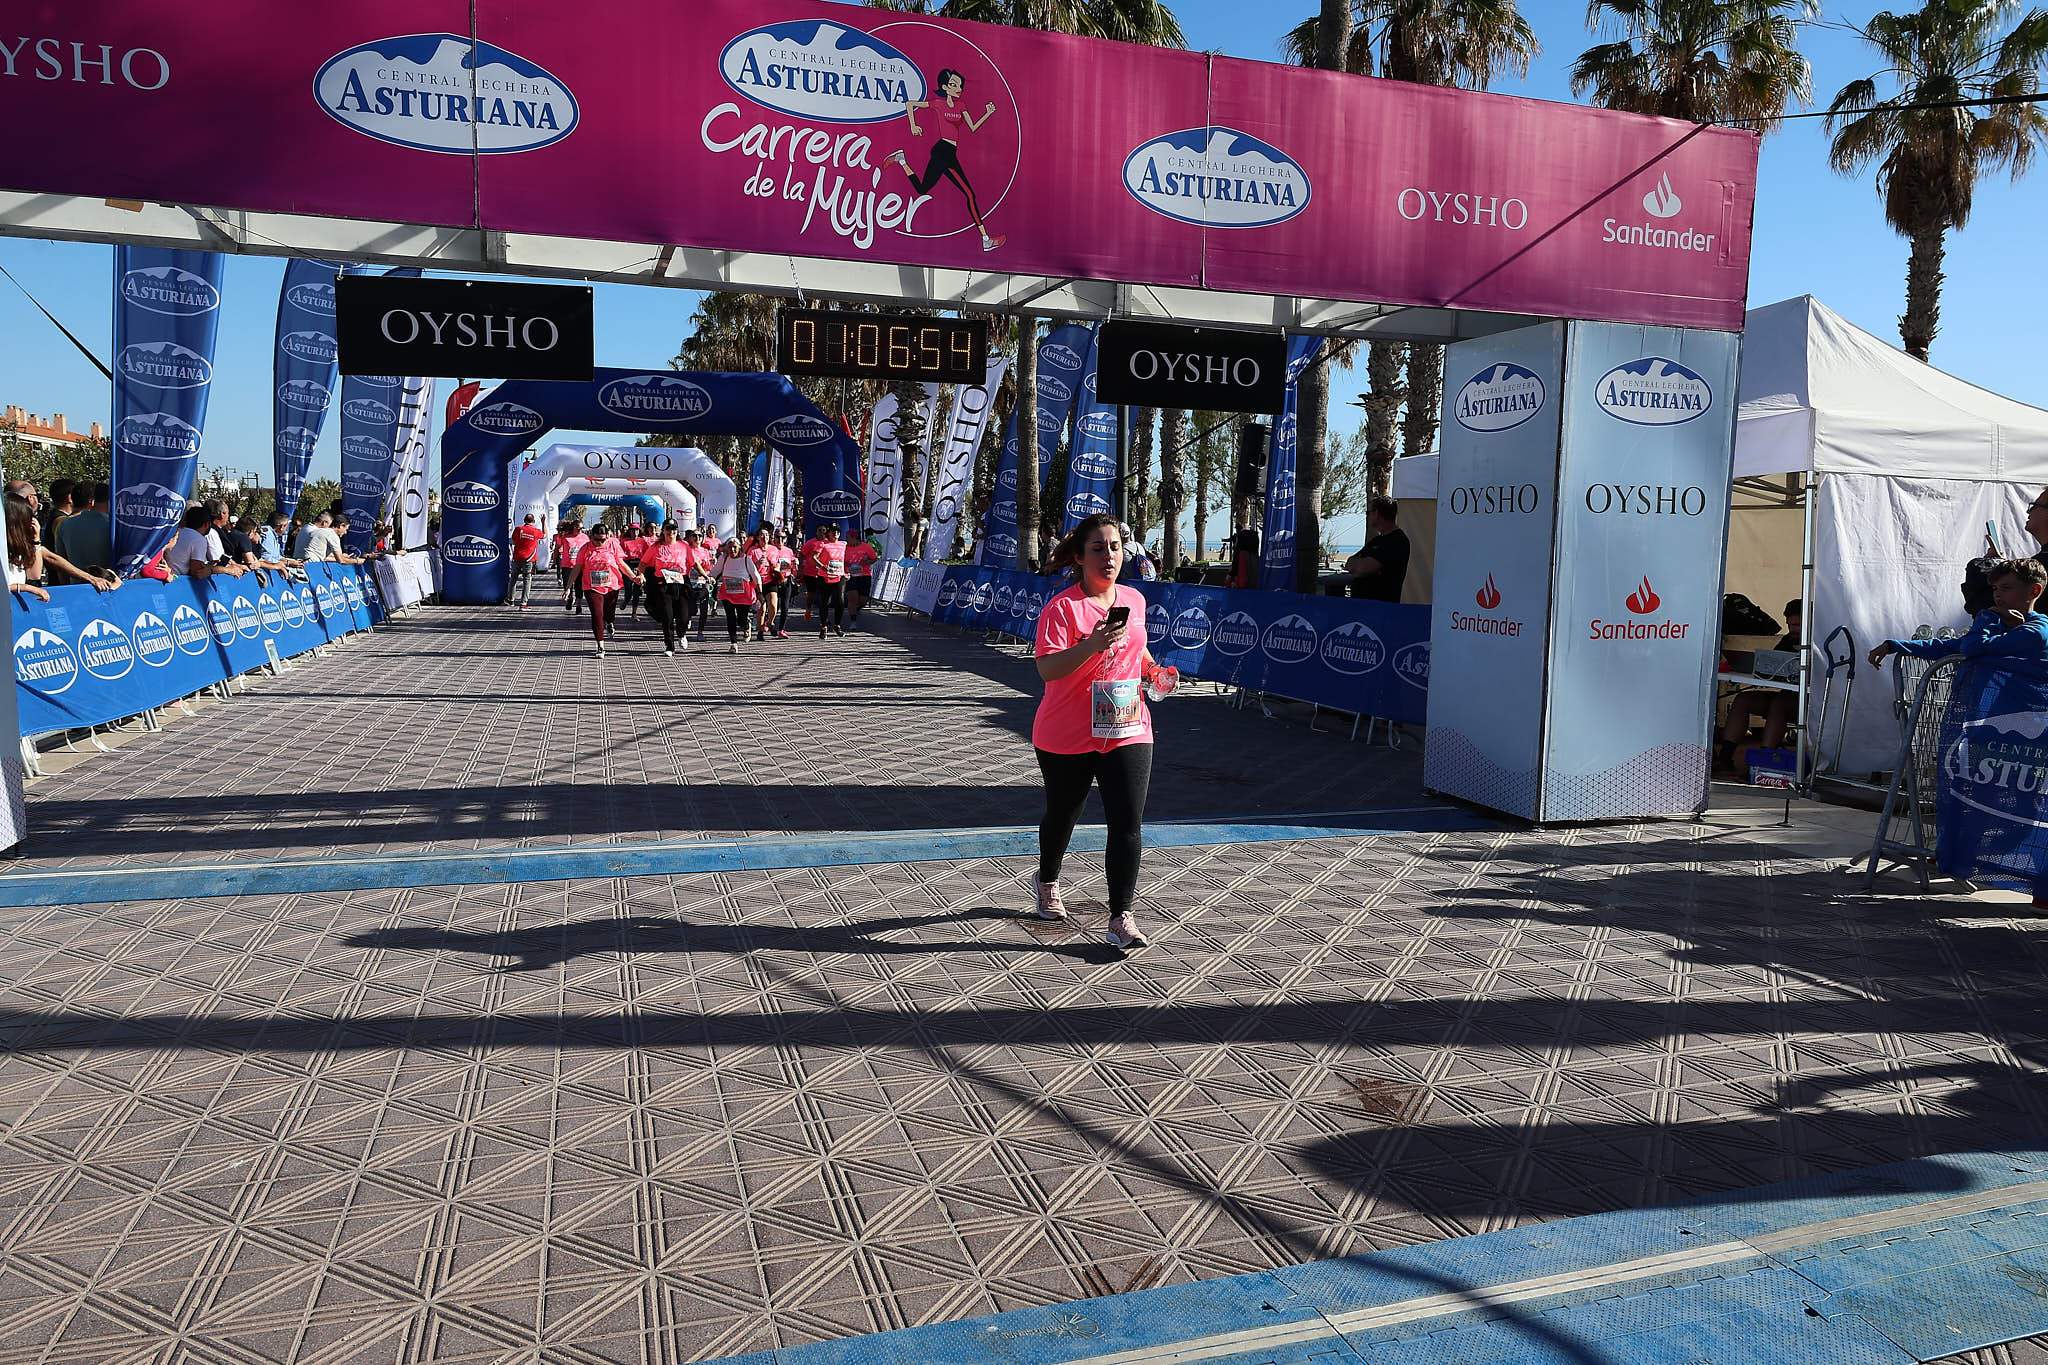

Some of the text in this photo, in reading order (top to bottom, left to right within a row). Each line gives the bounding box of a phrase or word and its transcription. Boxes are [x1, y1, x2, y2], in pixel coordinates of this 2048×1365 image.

[769, 48, 905, 75] CENTRAL LECHERA
[377, 68, 460, 88] CENTRAL
[736, 47, 910, 104] ASTURIANA
[336, 68, 560, 130] ASTURIANA
[701, 103, 871, 170] Carrera
[1168, 156, 1292, 178] CENTRAL LECHERA
[1137, 156, 1297, 207] ASTURIANA
[744, 161, 933, 249] de la Mujer
[1397, 187, 1529, 230] OYSHO
[1603, 218, 1715, 253] Santander
[125, 277, 211, 307] ASTURIANA
[381, 308, 560, 351] OYSHO
[793, 319, 971, 370] 01:06:54
[125, 352, 205, 381] ASTURIANA
[1129, 349, 1261, 387] OYSHO
[607, 387, 704, 411] ASTURIANA
[1037, 382, 1068, 399] STURIANA
[1472, 381, 1536, 398] CENTRAL LECHERA
[1603, 379, 1703, 411] ASTURIANA
[1622, 379, 1700, 392] CENTRAL LECHERA
[1459, 390, 1538, 418] ASTURIANA
[473, 412, 538, 428] ASTURIANA
[771, 426, 830, 439] ASTURIANA
[120, 425, 197, 452] ASTURIANA
[583, 451, 672, 472] OYSHO
[935, 384, 989, 524] OYSHO
[445, 493, 497, 505] ASTURIANA
[1450, 483, 1539, 515] OYSHO
[1585, 483, 1706, 516] OYSHO
[445, 545, 496, 558] ASTURIANA
[1173, 620, 1208, 640] ASTURIANA
[1215, 625, 1254, 646] ASTURIANA
[1451, 611, 1523, 637] Santander
[1589, 618, 1690, 641] Santander
[1264, 630, 1312, 653] ASTURIANA
[1324, 637, 1377, 665] ASTURIANA
[16, 656, 76, 682] ASTURIANA
[84, 645, 133, 668] ASTURIANA
